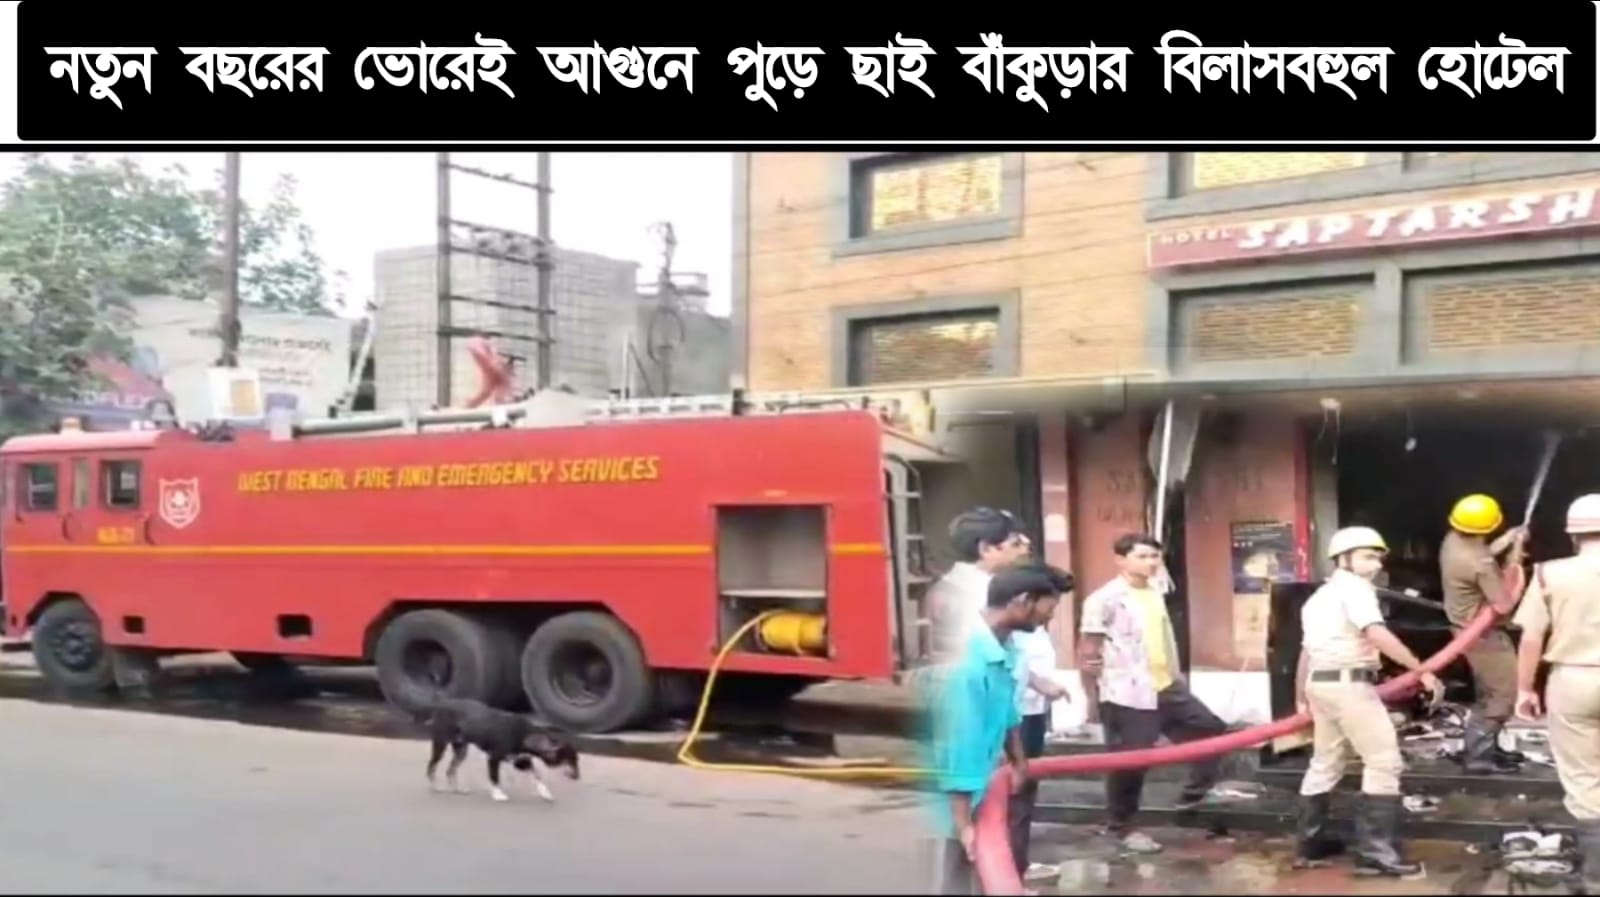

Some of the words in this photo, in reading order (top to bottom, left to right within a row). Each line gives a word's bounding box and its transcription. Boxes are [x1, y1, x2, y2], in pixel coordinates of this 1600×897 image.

[237, 469, 282, 492] WEST
[284, 468, 349, 491] BENGAL
[397, 464, 434, 488] AND
[437, 458, 553, 486] EMERGENCY
[557, 454, 661, 484] SERVICES
